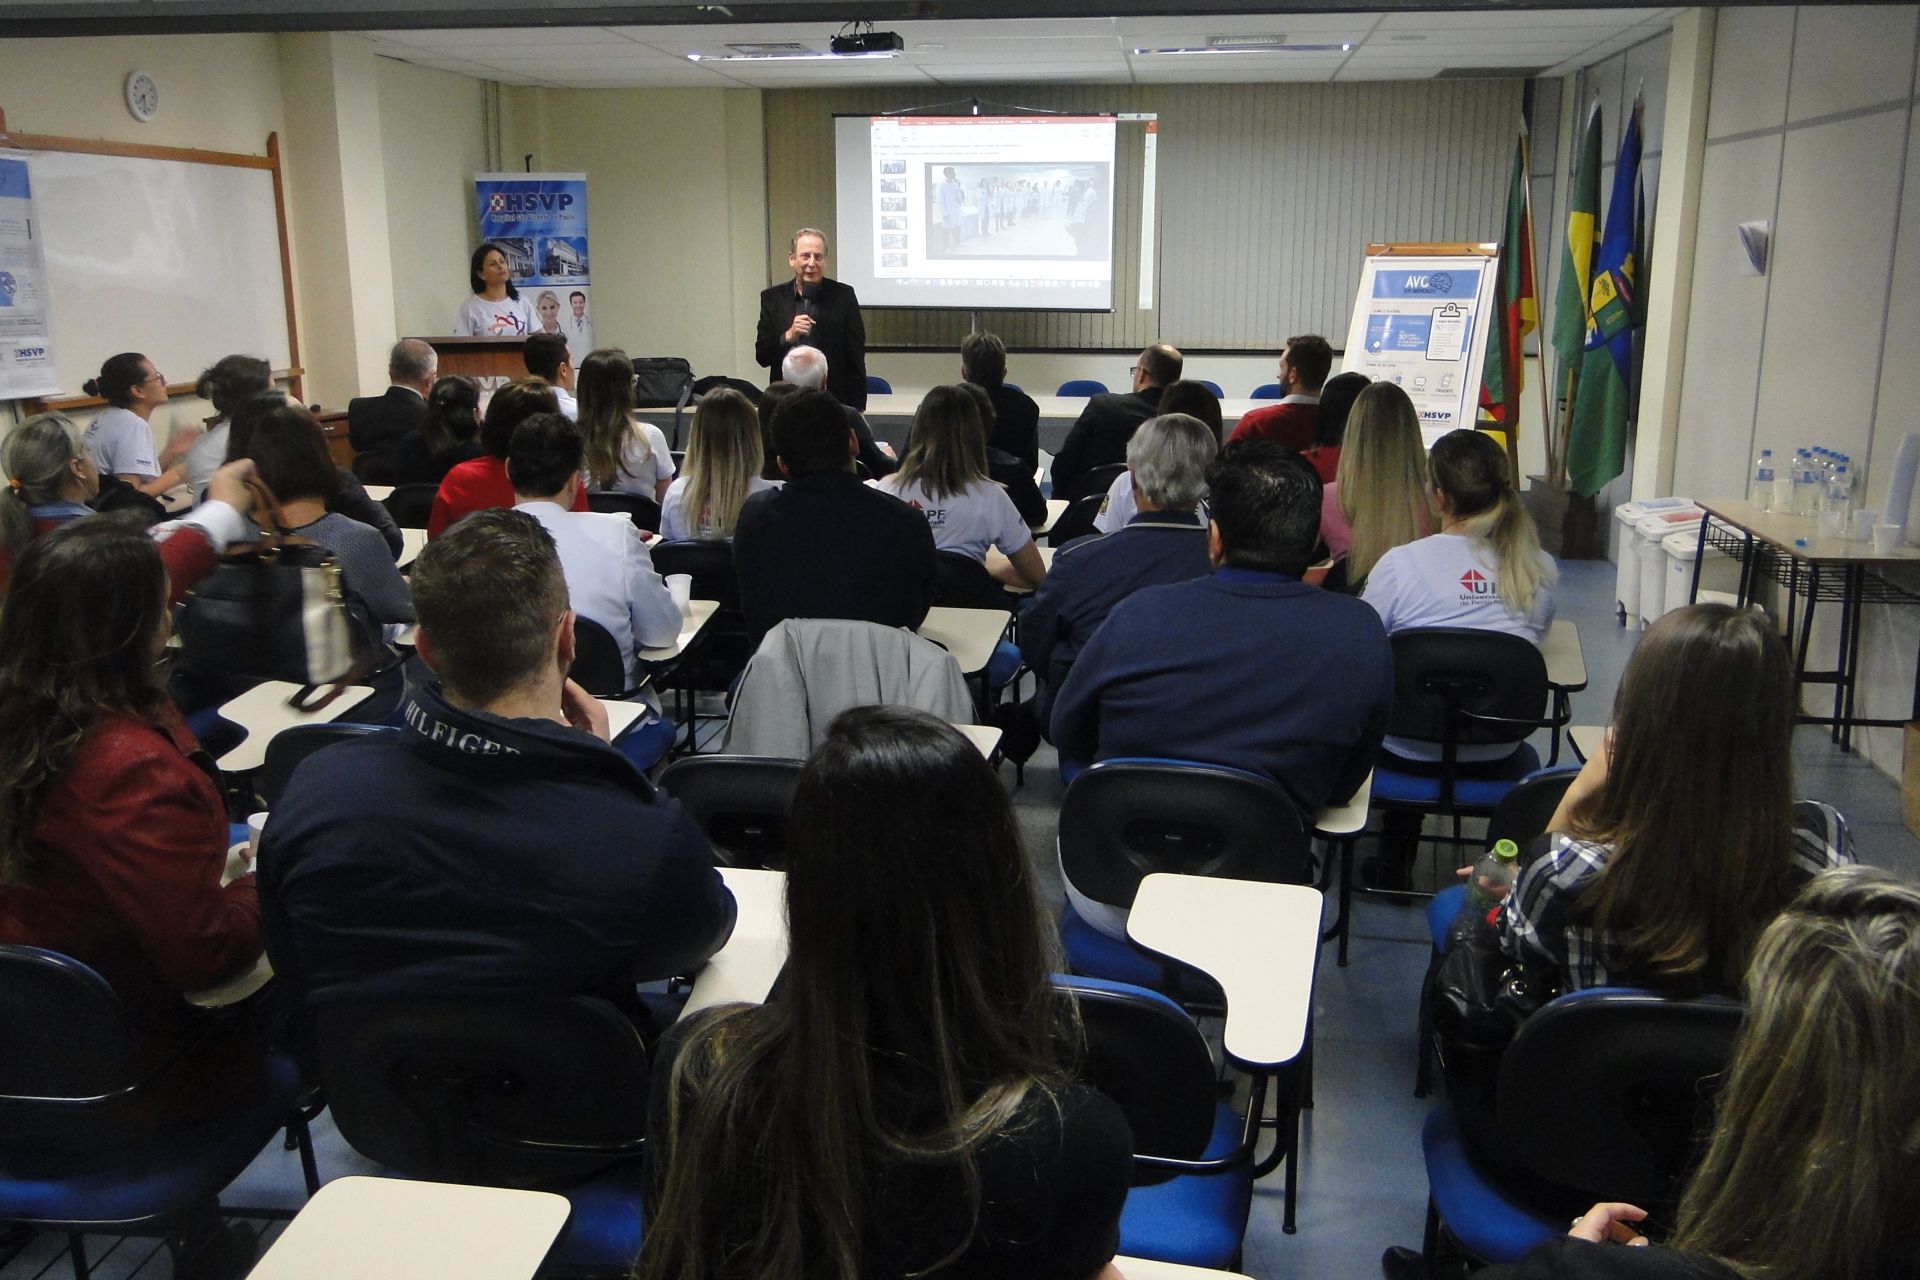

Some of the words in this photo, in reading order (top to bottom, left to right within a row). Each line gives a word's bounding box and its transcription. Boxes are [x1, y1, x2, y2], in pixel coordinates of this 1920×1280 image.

[505, 192, 574, 211] HSVP
[1405, 275, 1430, 288] AVC
[20, 347, 45, 357] HSVP
[1424, 411, 1451, 419] HSVP
[926, 509, 947, 520] PF
[404, 699, 521, 755] HILFIGE
